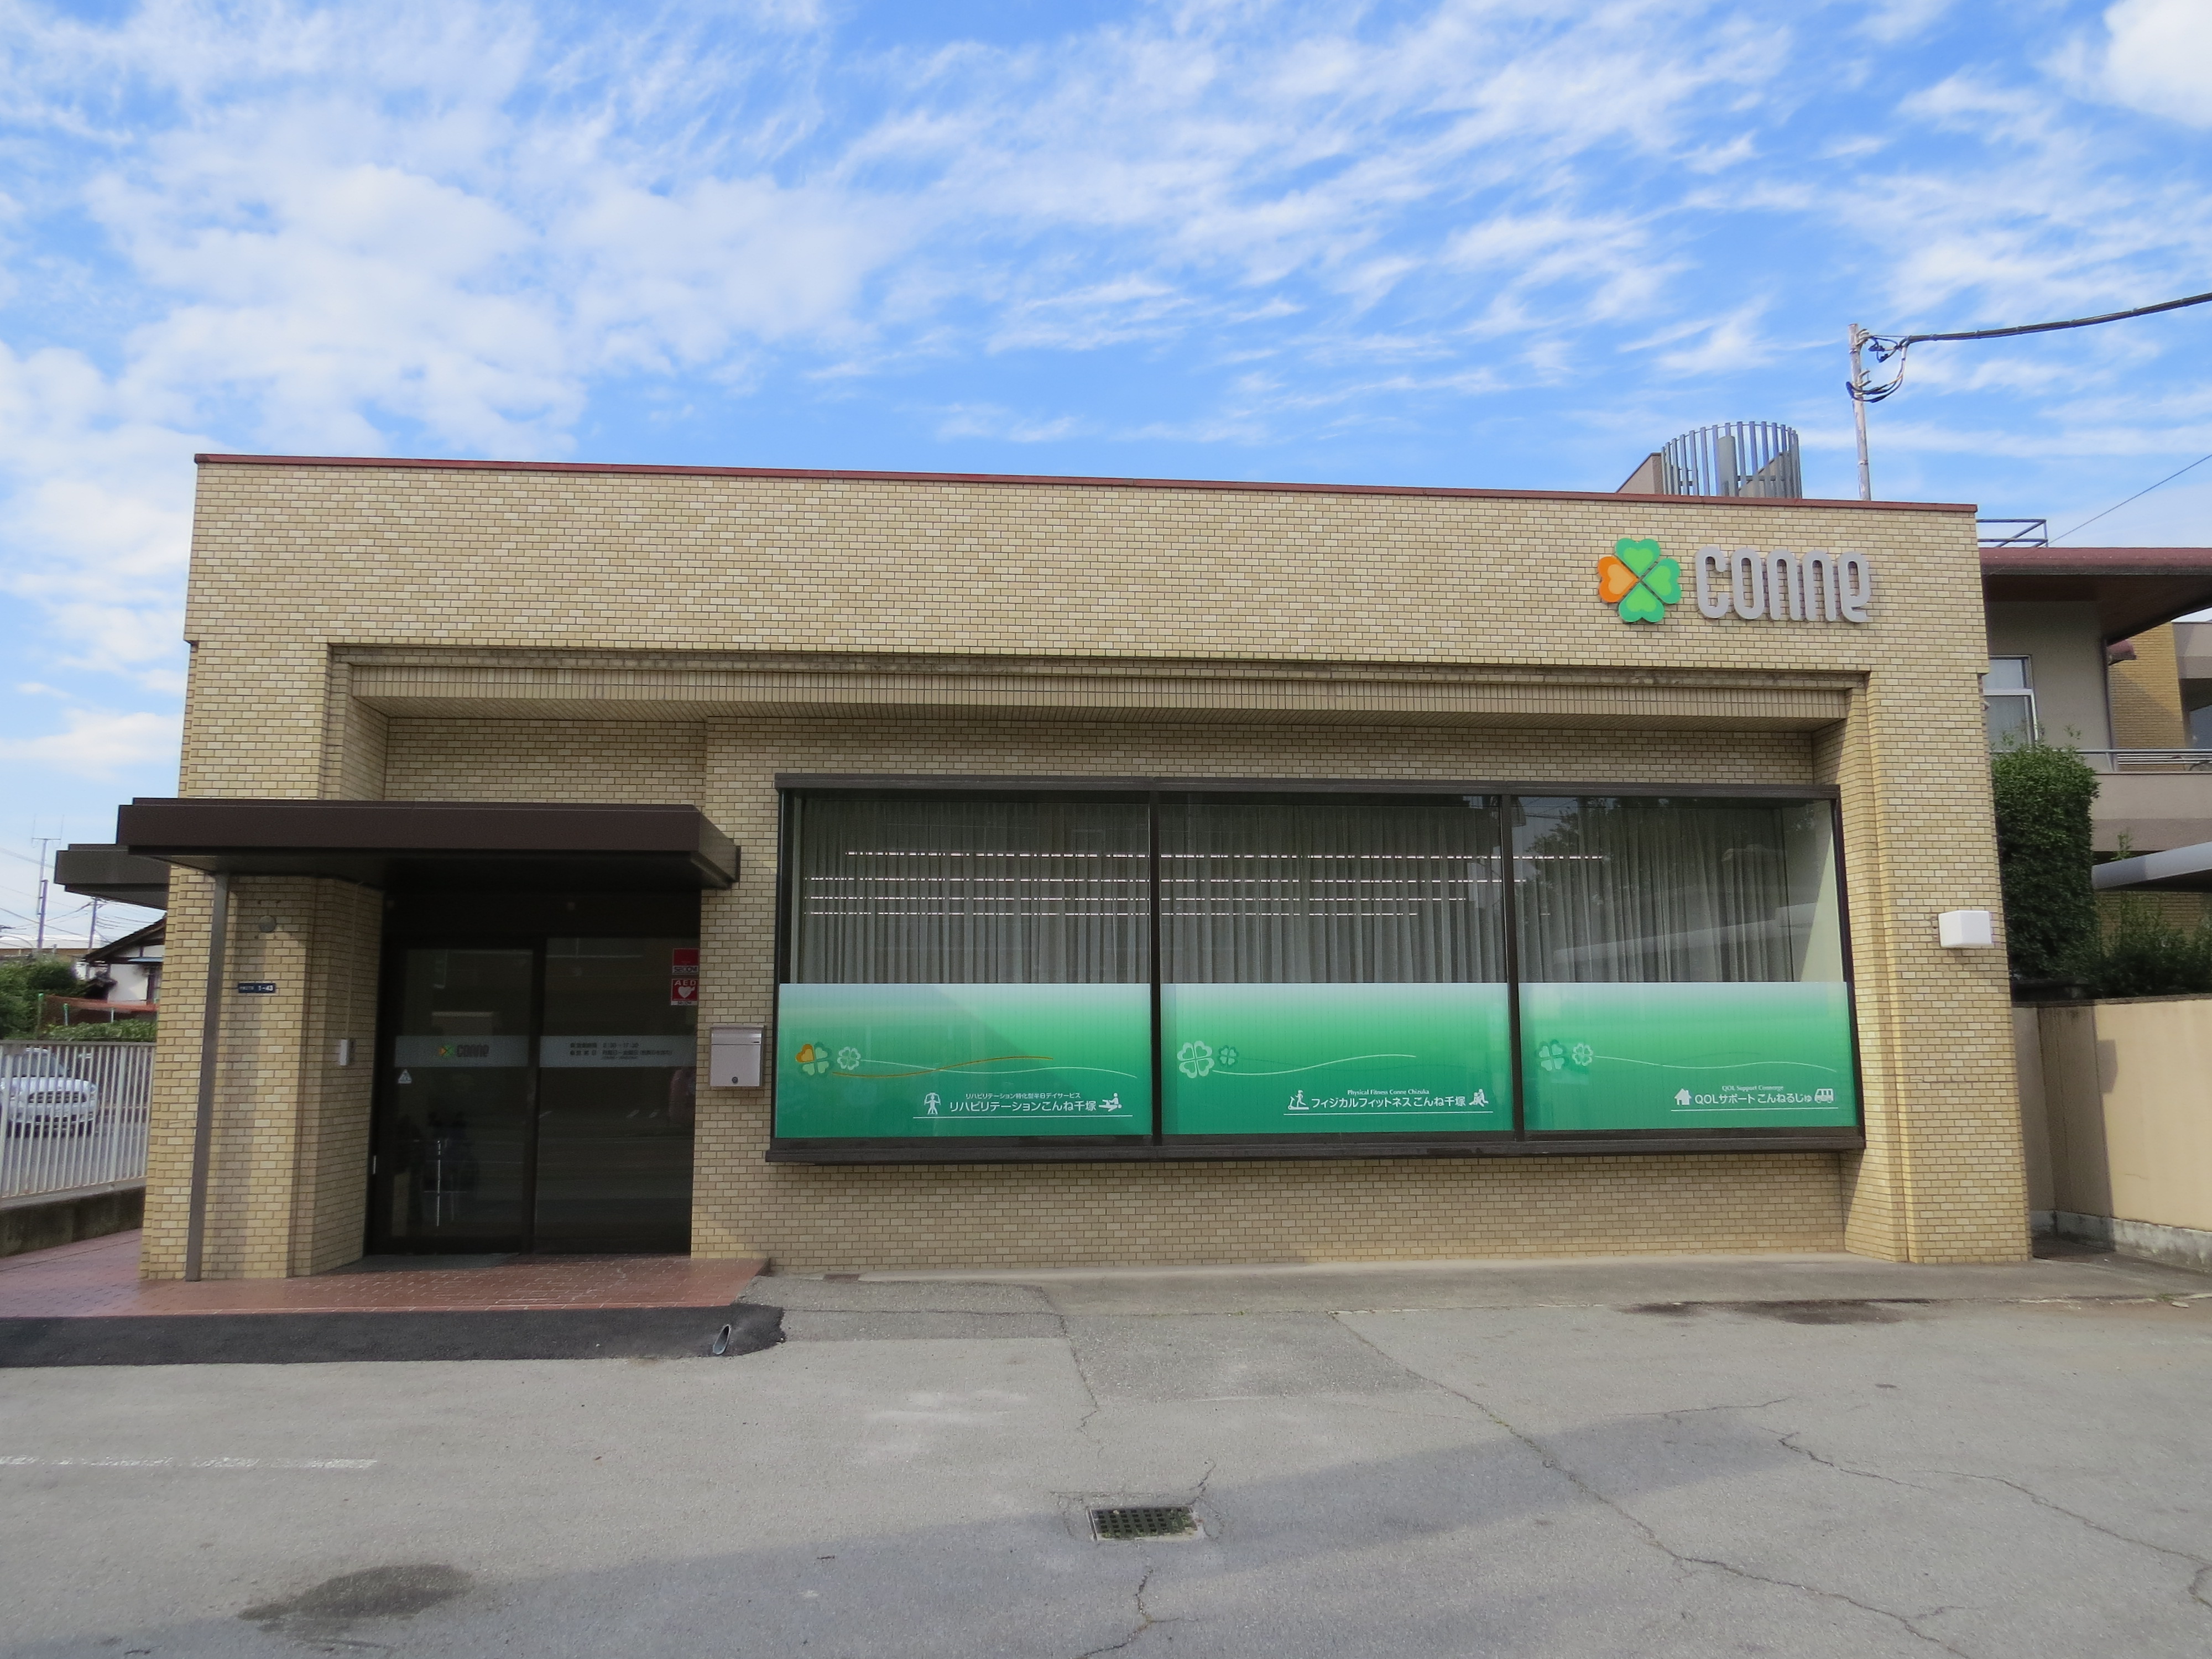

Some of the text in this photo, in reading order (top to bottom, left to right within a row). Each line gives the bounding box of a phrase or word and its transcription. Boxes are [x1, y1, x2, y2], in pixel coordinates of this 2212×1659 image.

[1311, 1096, 1466, 1108] フィジカルフィットネス こんね千塚
[1695, 1094, 1755, 1104] QOLサポート
[950, 1100, 1096, 1112] リハビリテーションこんね千塚
